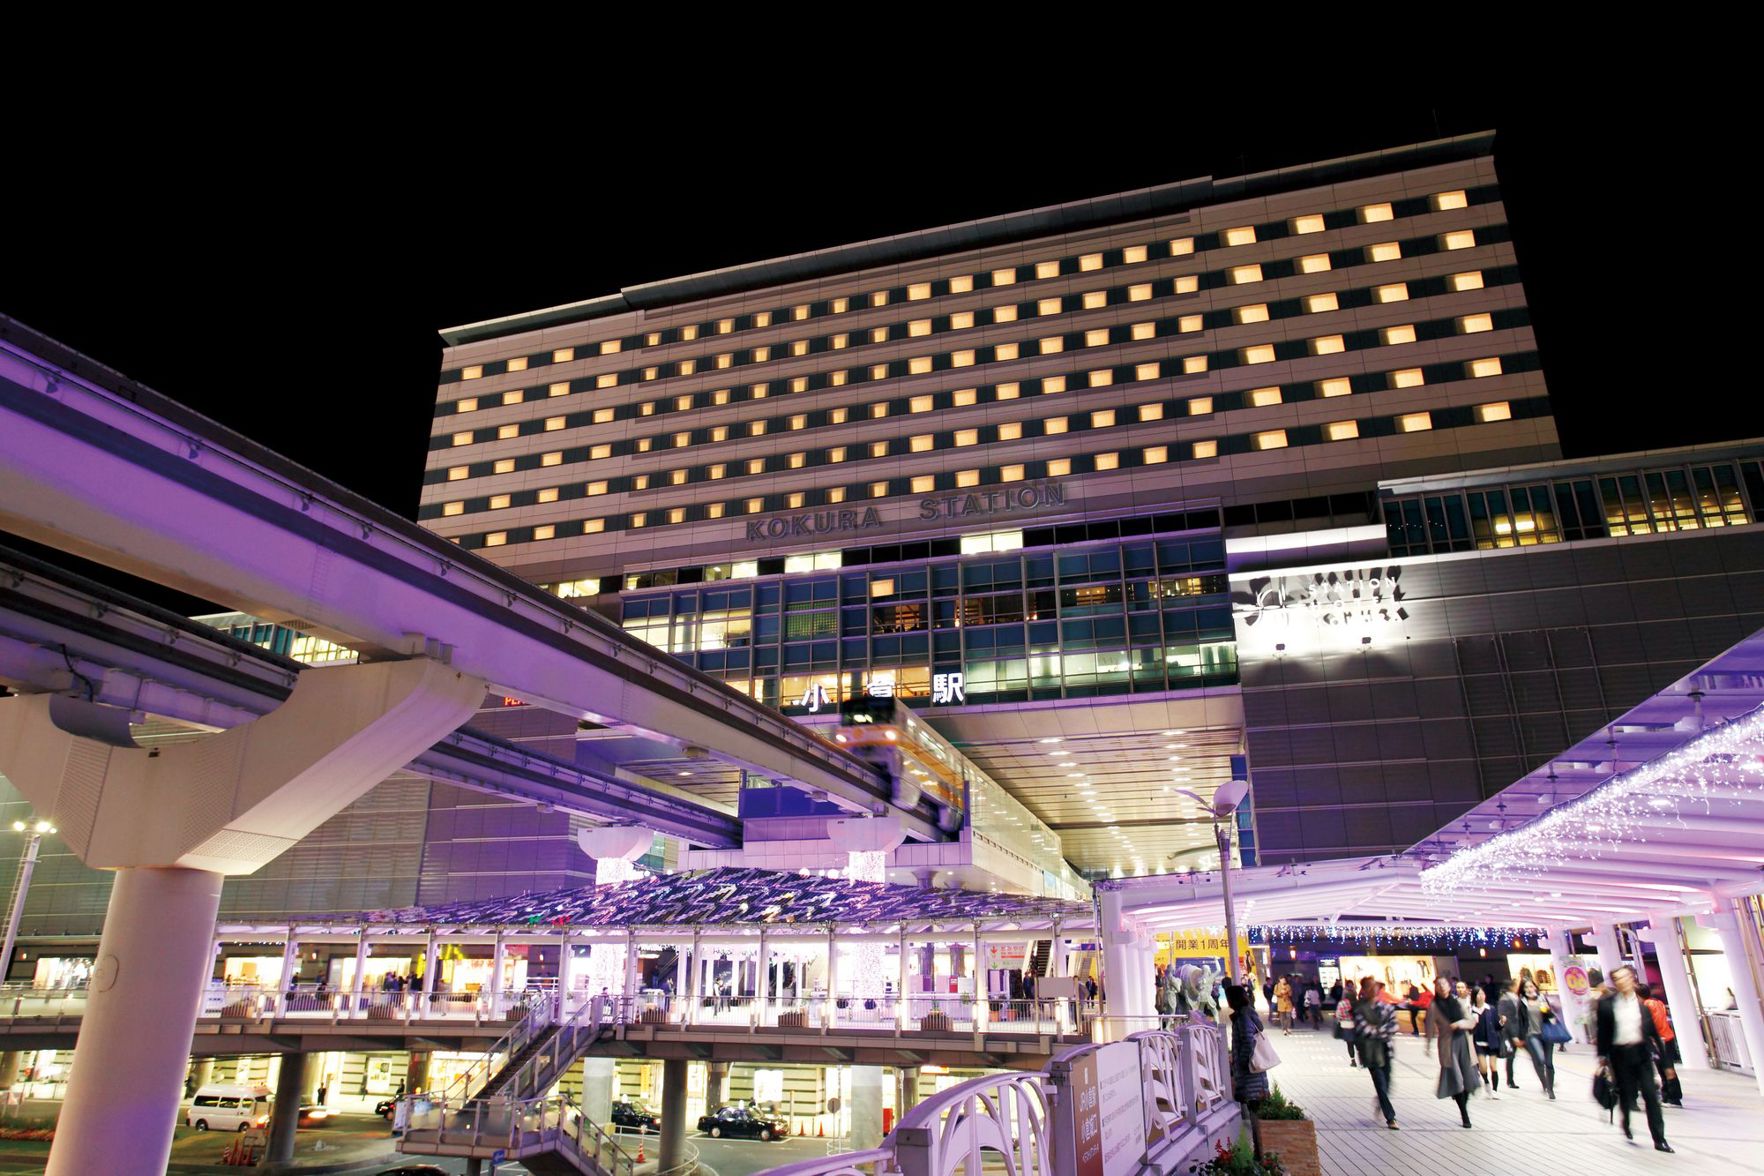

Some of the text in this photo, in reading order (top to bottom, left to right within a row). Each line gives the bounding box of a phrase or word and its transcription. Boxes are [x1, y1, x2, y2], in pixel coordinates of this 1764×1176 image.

[745, 482, 1066, 542] KOKURA STATION
[1308, 576, 1397, 594] STATION
[1175, 938, 1230, 950] 開業1周年
